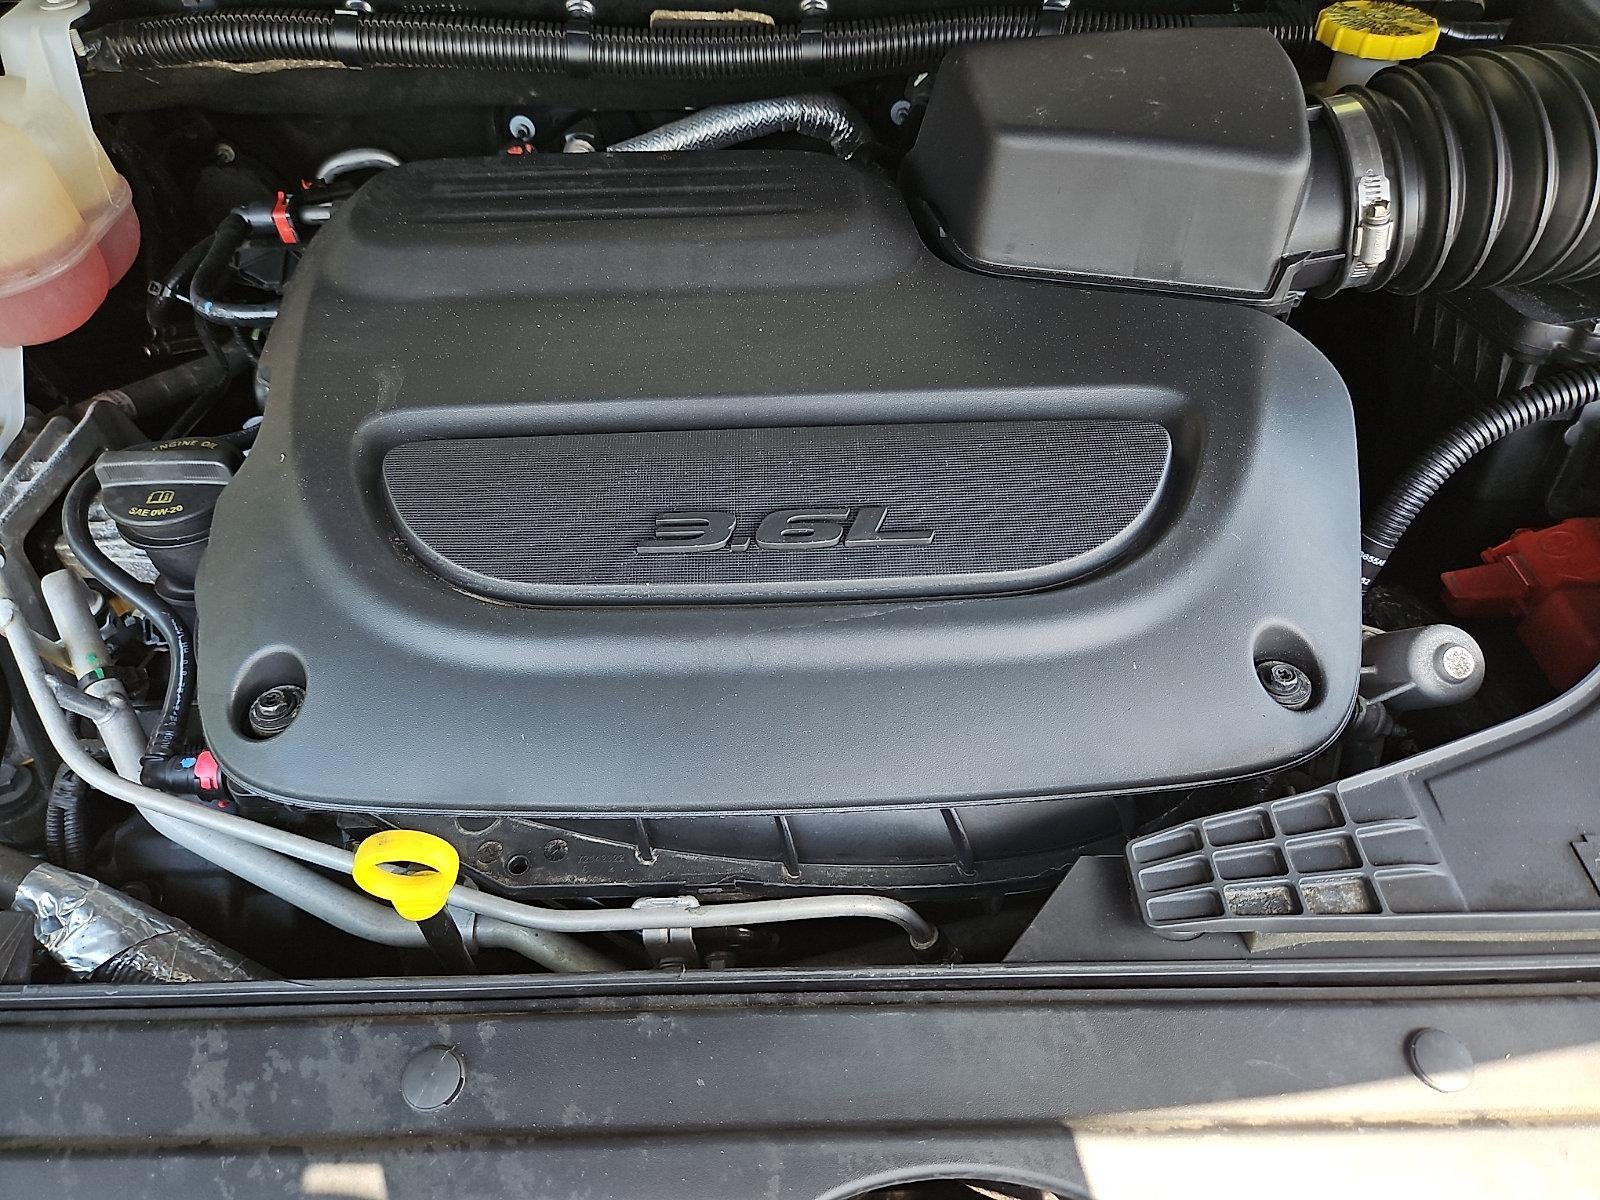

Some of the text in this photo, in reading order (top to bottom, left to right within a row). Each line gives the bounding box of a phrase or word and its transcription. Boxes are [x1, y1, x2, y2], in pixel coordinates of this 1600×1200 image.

[201, 440, 219, 450] OIL
[129, 504, 184, 517] SAE 0W-20
[636, 506, 936, 553] 3.6L
